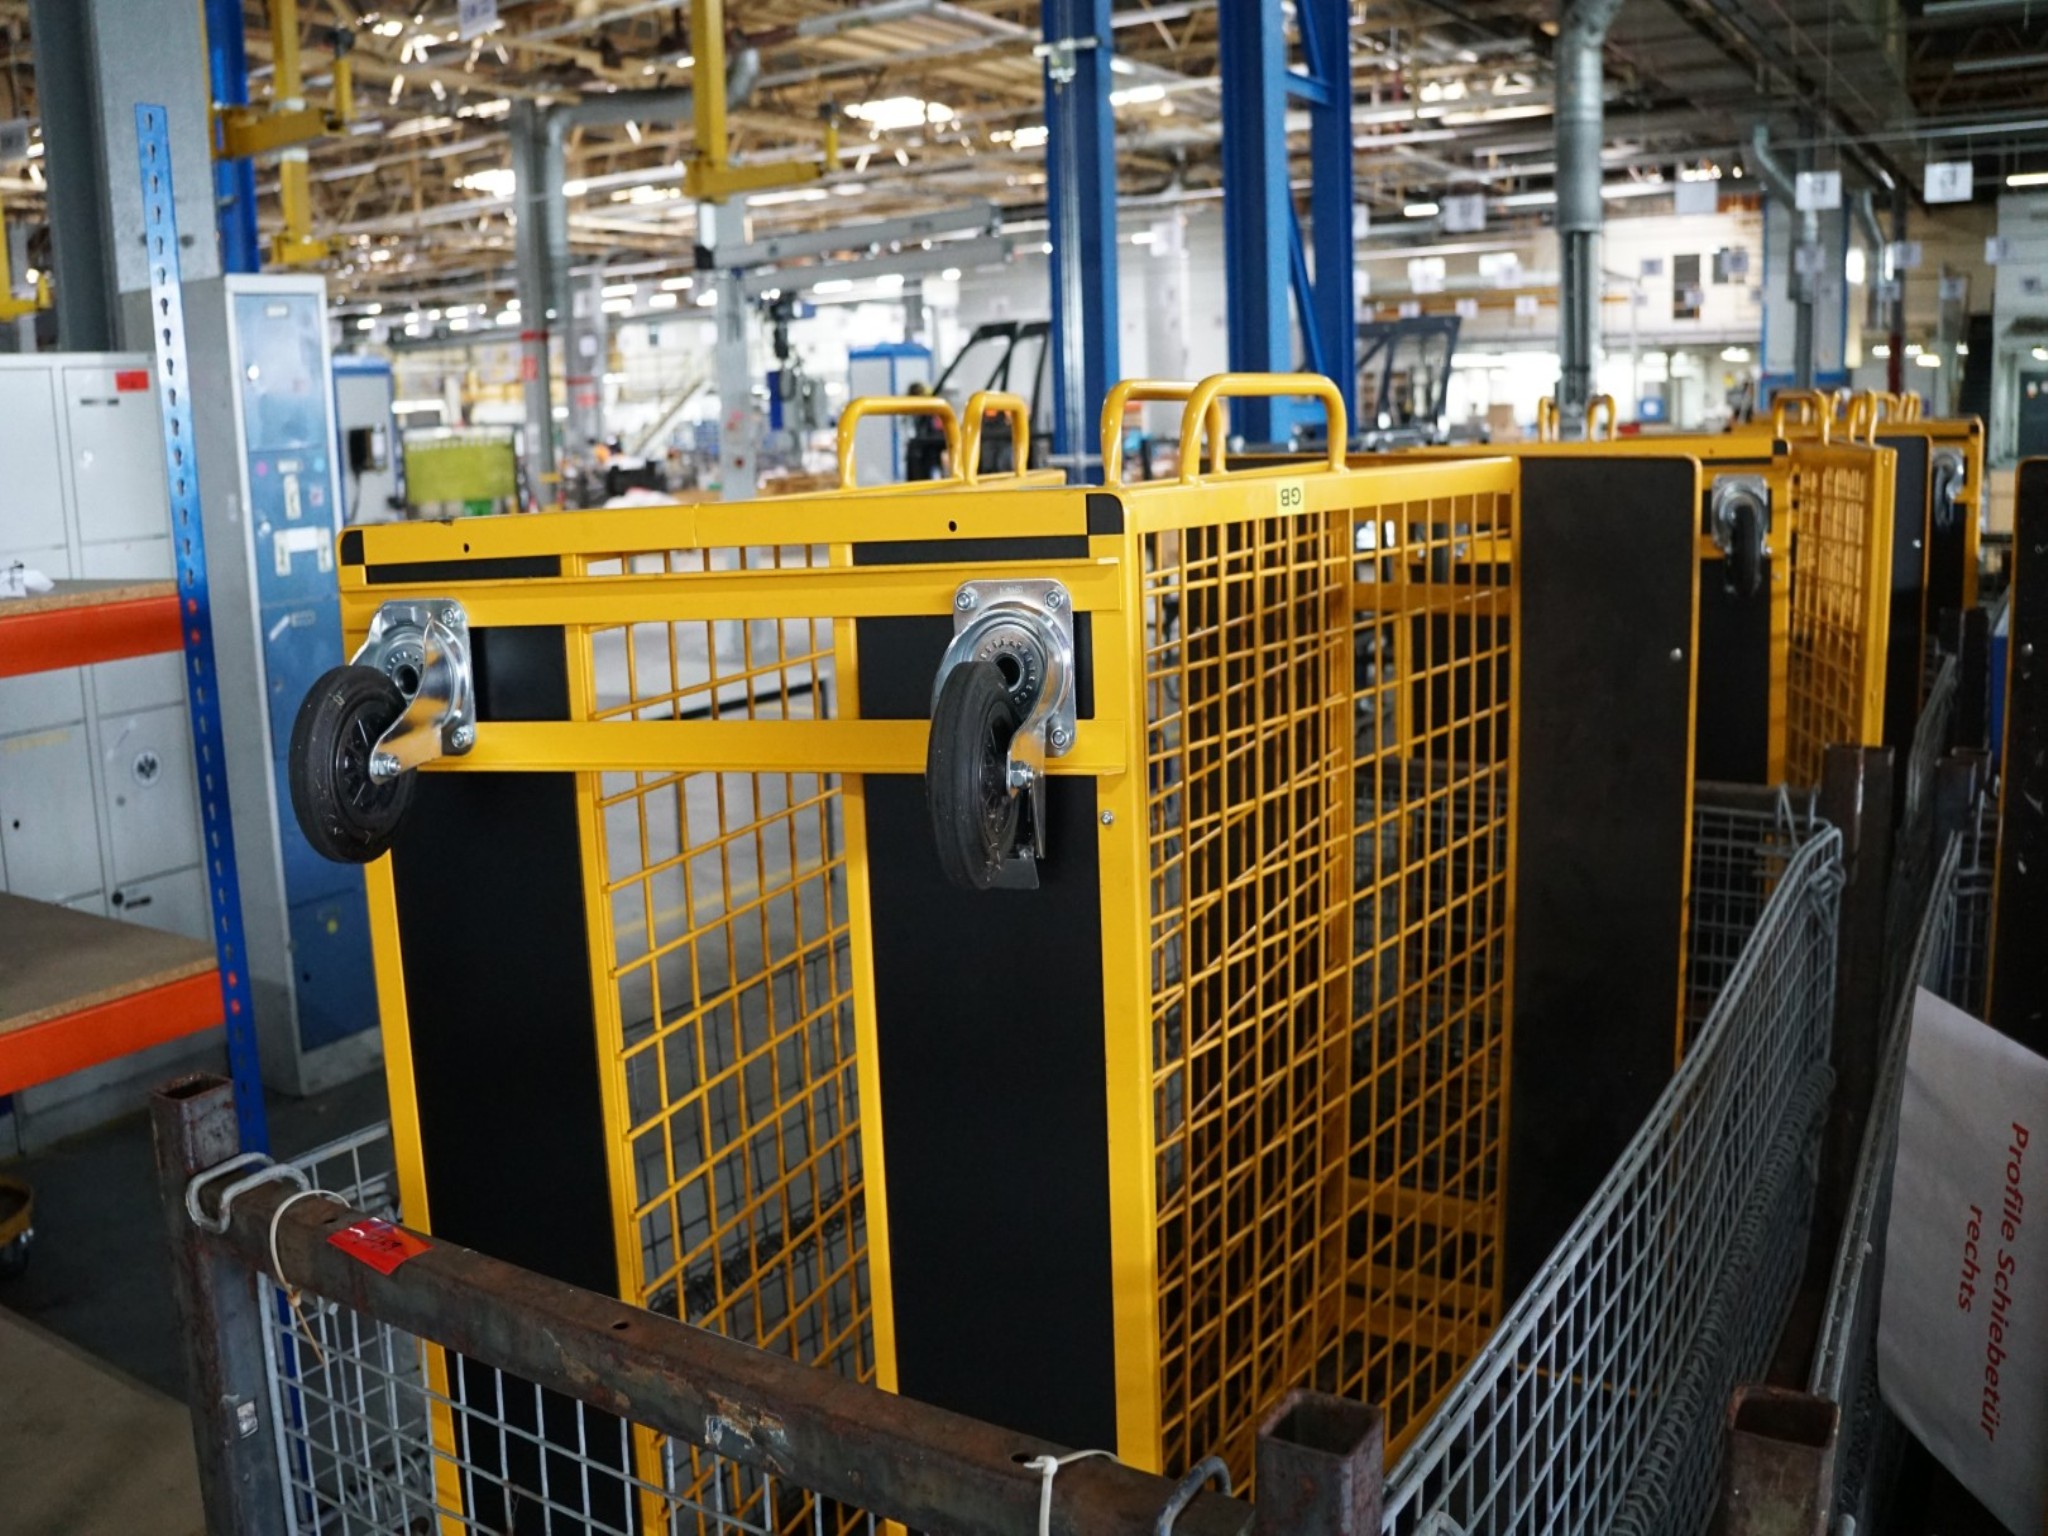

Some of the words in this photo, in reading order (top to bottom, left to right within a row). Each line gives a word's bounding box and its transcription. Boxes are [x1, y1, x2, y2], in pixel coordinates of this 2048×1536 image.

[1281, 487, 1301, 507] GB
[2001, 1122, 2029, 1242] Profile
[1958, 1204, 1982, 1313] rechts
[1980, 1249, 2015, 1443] Schiebetür
